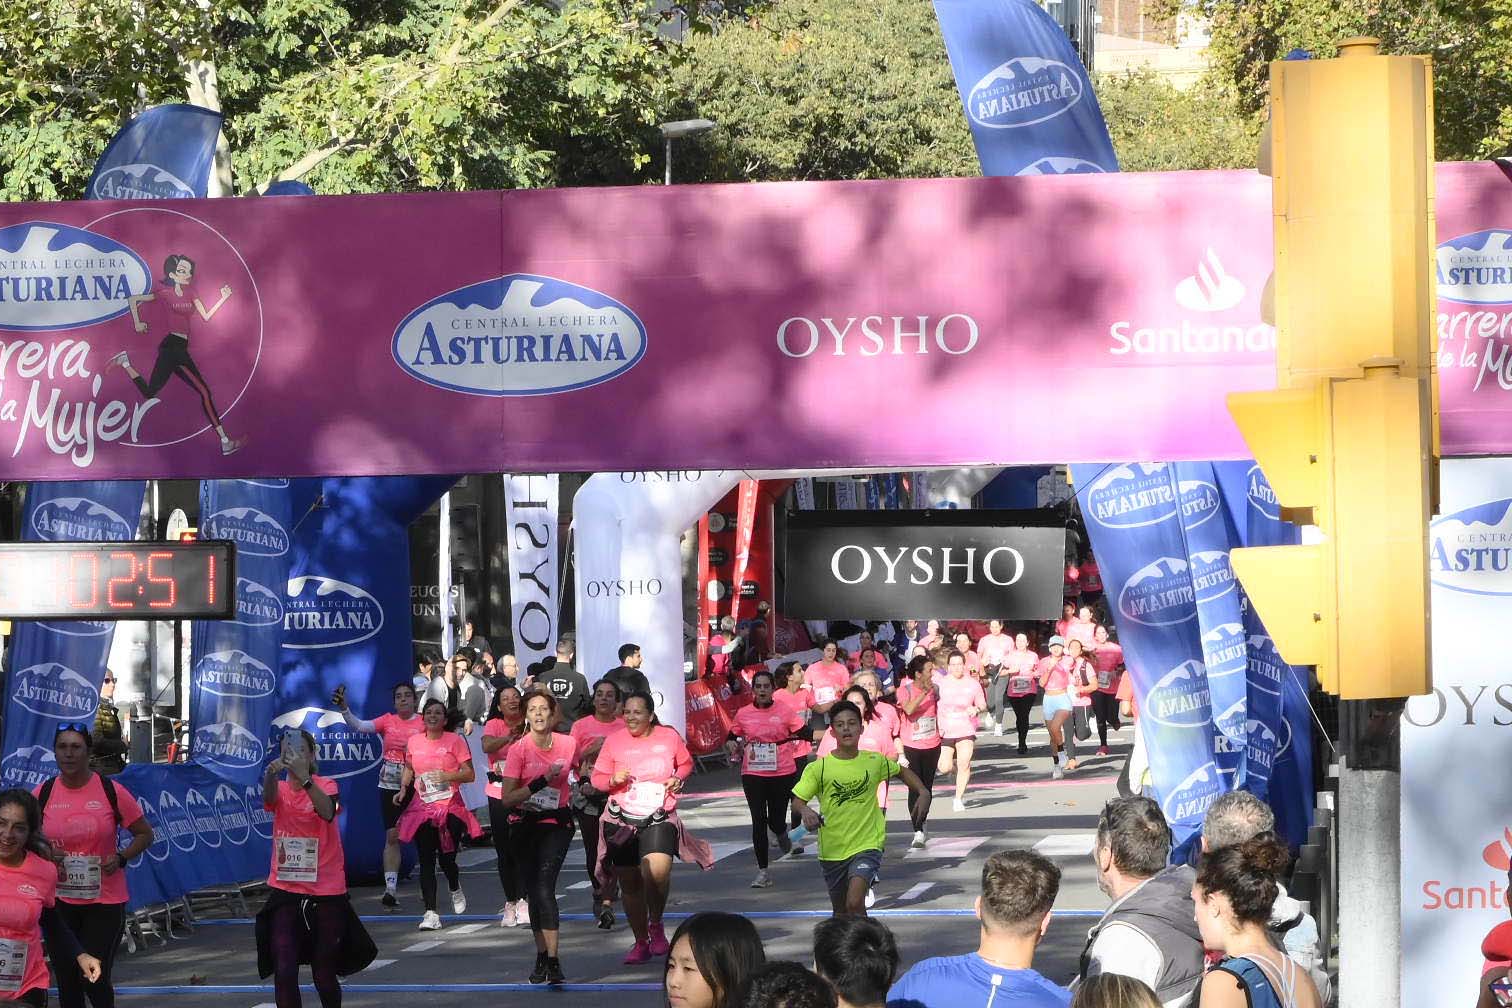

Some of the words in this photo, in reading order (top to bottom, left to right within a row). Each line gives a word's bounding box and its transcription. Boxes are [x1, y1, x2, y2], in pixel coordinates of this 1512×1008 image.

[54, 257, 128, 270] LECHERA
[451, 316, 529, 330] CENTRAL
[537, 314, 619, 328] LECHERA
[776, 312, 979, 359] OYSHO
[411, 320, 628, 366] ASTURIANA
[1459, 339, 1478, 368] la
[11, 373, 162, 468] Mujer
[210, 519, 285, 551] ASTURIANA
[830, 544, 1026, 587] OYSHO
[586, 577, 663, 599] OYSHO
[15, 675, 92, 713] ASTURIANA
[552, 682, 567, 692] BP
[313, 741, 376, 762] RIANA
